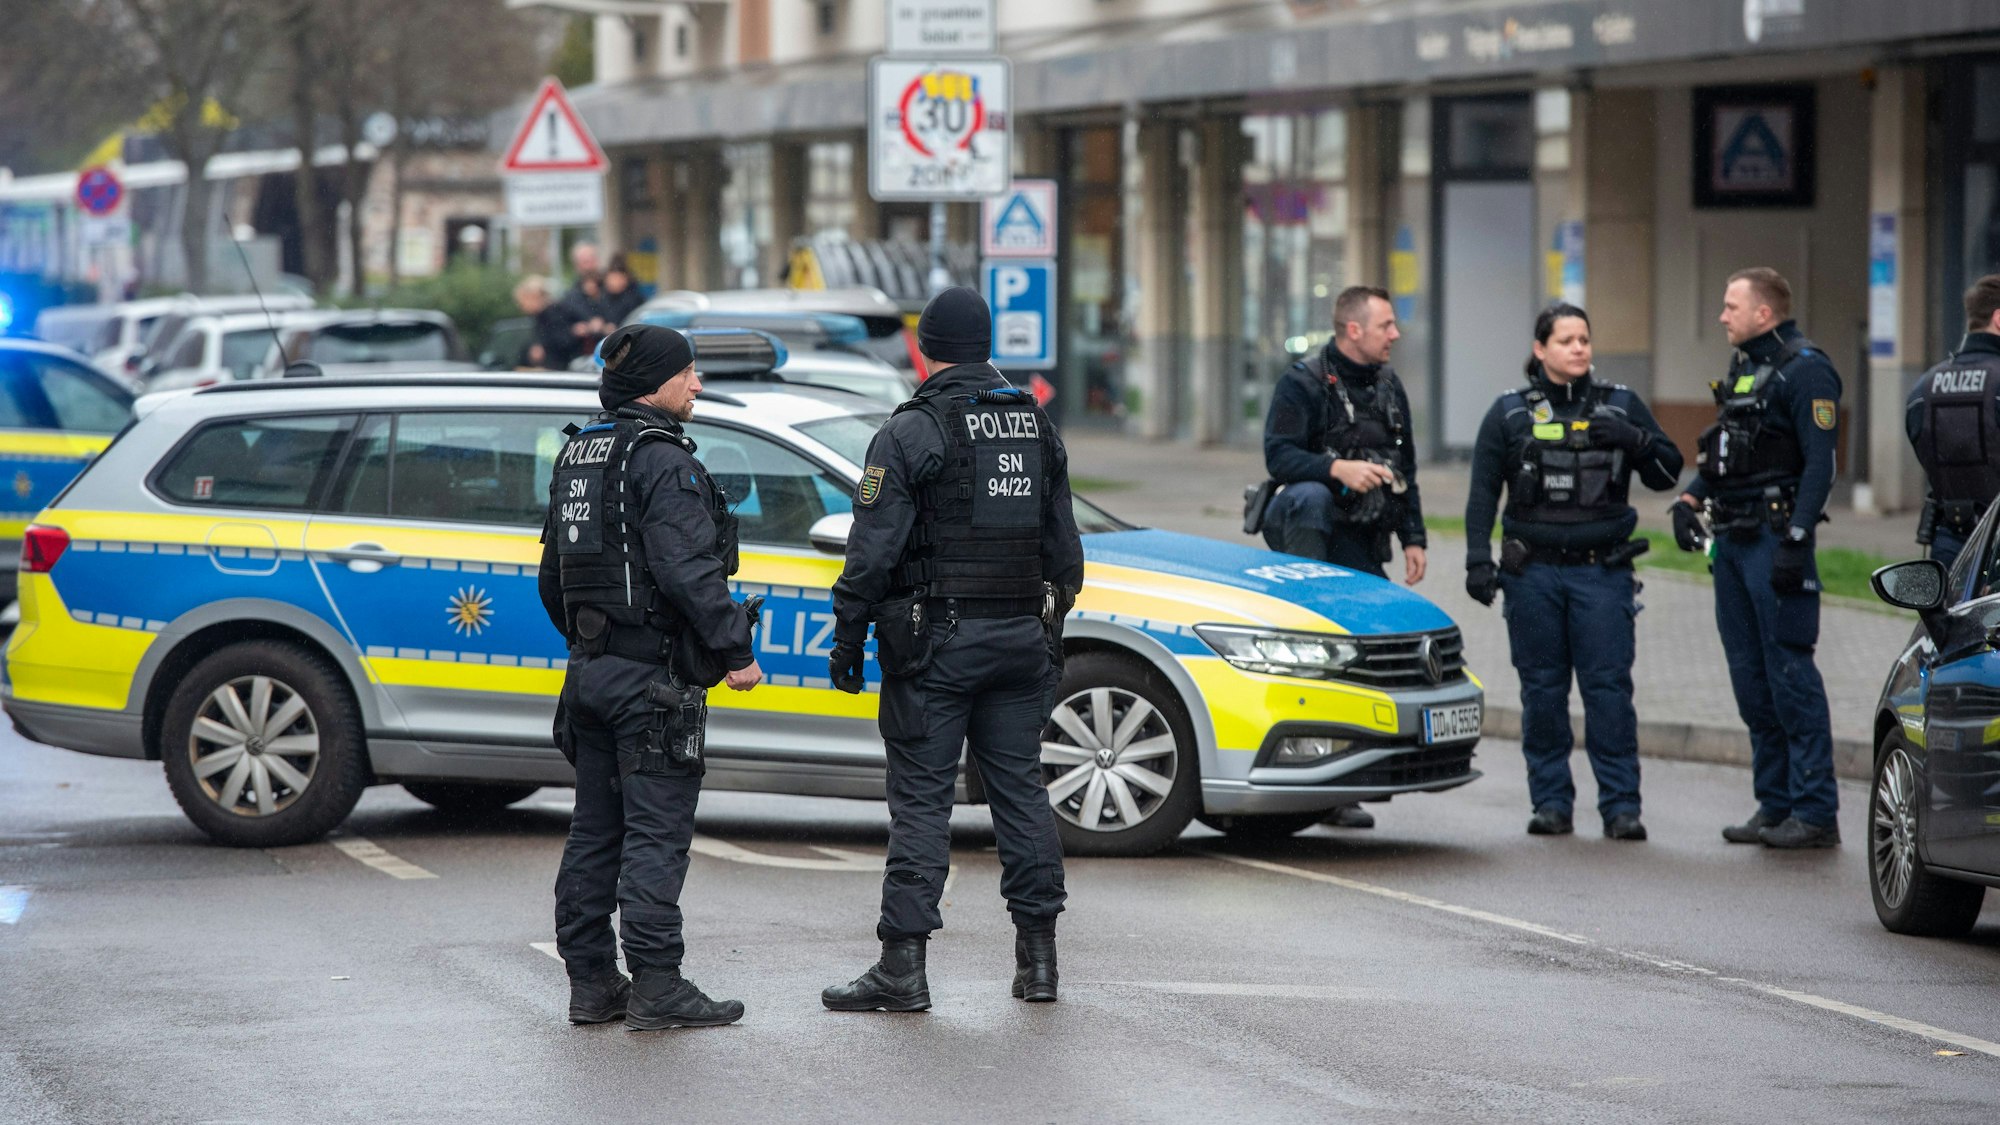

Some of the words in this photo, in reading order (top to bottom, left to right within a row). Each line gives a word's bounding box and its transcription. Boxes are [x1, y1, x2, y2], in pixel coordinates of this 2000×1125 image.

[1931, 369, 1987, 395] POLIZEI
[965, 411, 1040, 440] POLIZEI
[560, 436, 616, 468] POLIZEI
[998, 453, 1024, 473] SN
[569, 478, 588, 498] SN
[988, 477, 1032, 497] 94/22
[1544, 474, 1575, 489] POLIZEI
[561, 502, 590, 522] 94/22
[1432, 712, 1445, 737] DD
